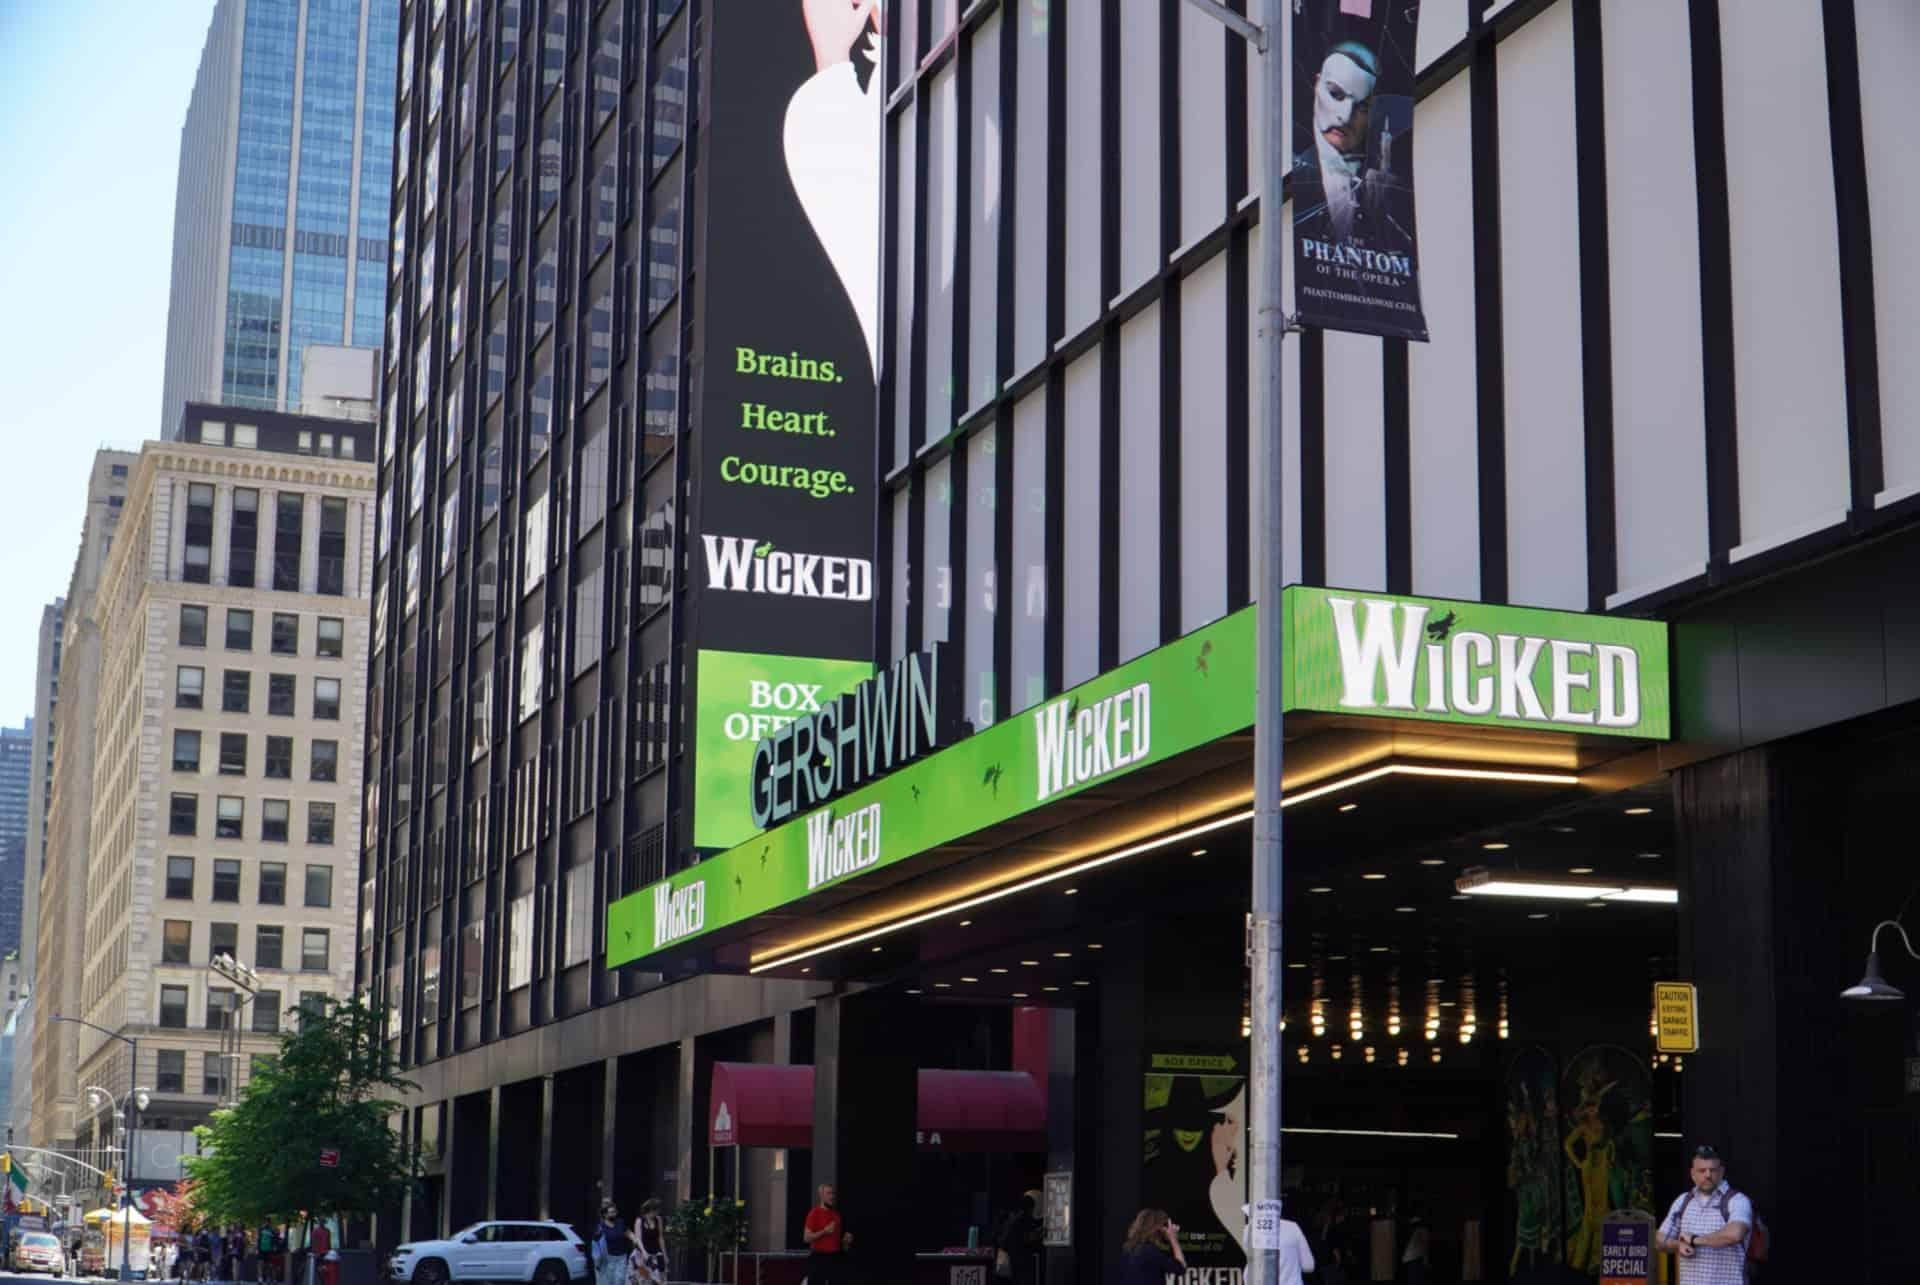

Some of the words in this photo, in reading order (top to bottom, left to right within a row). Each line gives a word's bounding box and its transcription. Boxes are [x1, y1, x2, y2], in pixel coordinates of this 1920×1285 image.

[1301, 238, 1411, 277] PHANTOM
[1316, 263, 1331, 275] OF
[1335, 266, 1358, 280] THE
[1362, 272, 1400, 287] OPERA
[735, 347, 843, 383] Brains.
[741, 403, 836, 437] Heart.
[720, 457, 854, 498] Courage.
[750, 680, 823, 712] BOX
[724, 712, 799, 742] OFF
[751, 640, 938, 829] GERSHWIN
[1660, 991, 1688, 1002] CAUTION
[1603, 1245, 1626, 1257] EARLY
[1629, 1245, 1648, 1257] BIRD
[1602, 1259, 1648, 1276] SPECIAL
